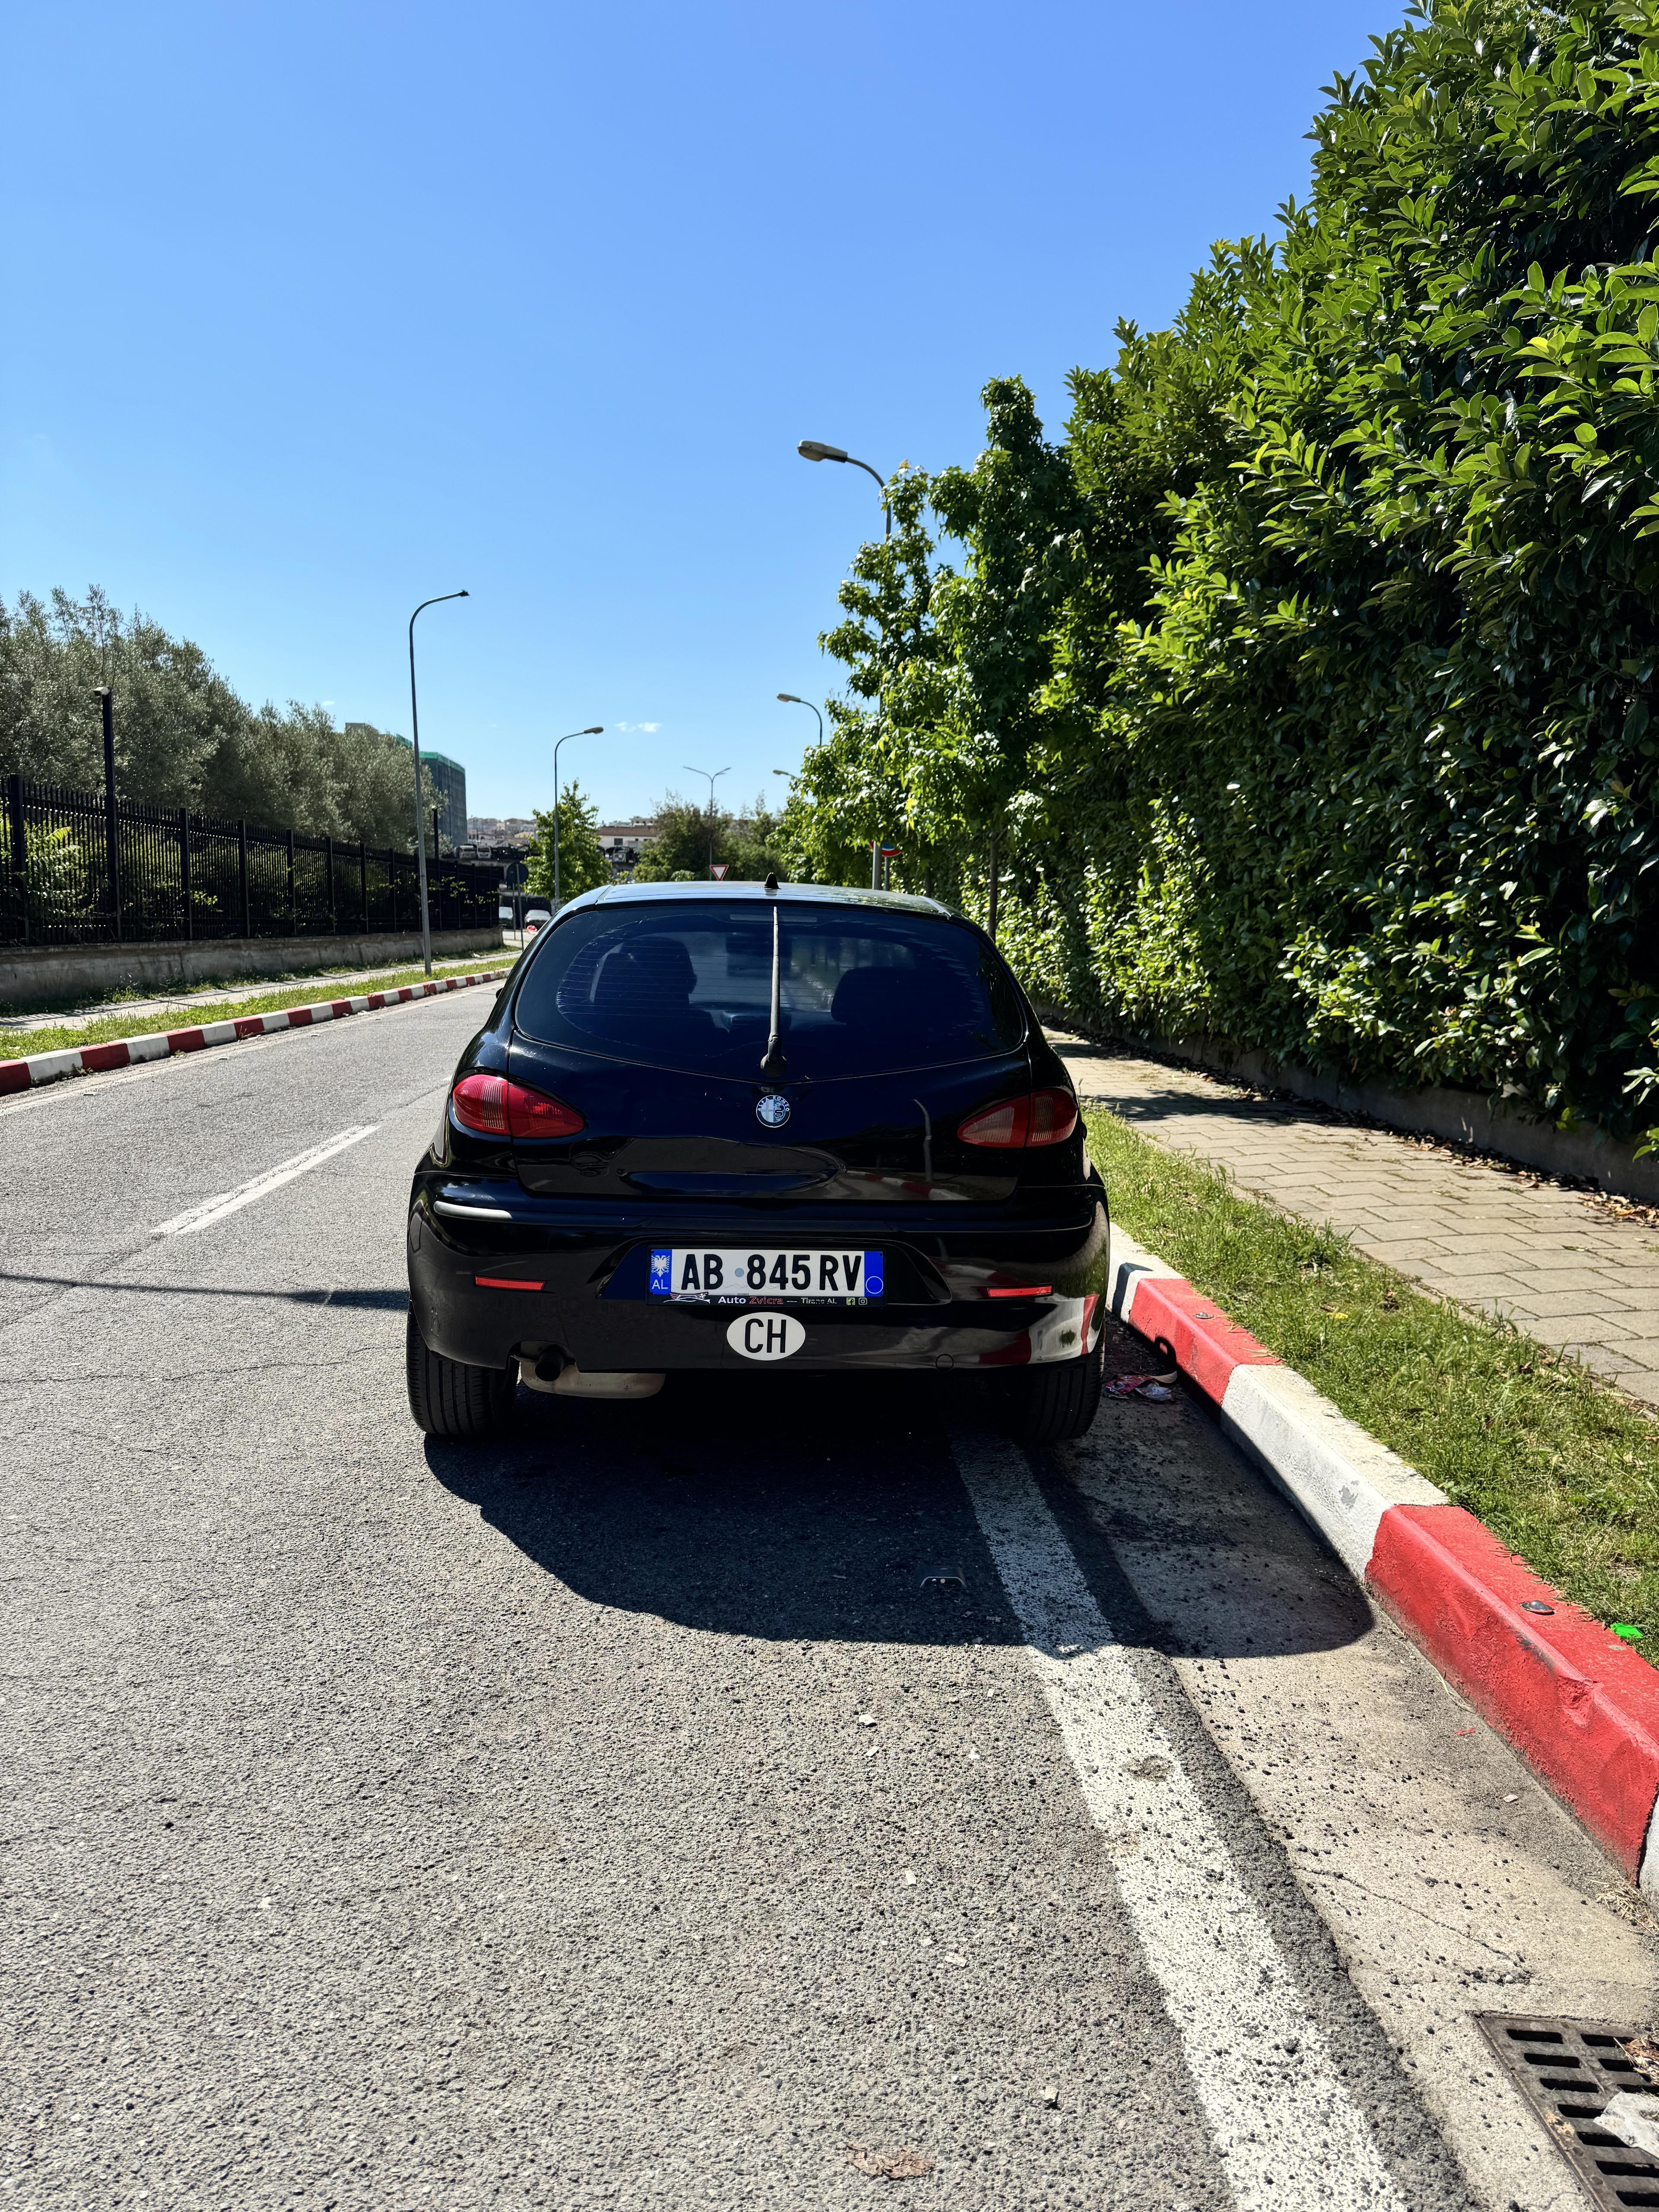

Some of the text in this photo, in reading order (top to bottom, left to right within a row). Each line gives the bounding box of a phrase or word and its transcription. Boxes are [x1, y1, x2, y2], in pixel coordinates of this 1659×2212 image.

[772, 1096, 790, 1112] ROMEO
[681, 1254, 723, 1290] AB
[652, 1279, 668, 1290] AL
[718, 1296, 746, 1304] Auto
[749, 1296, 784, 1305] Zvicra
[744, 1318, 787, 1354] CH
